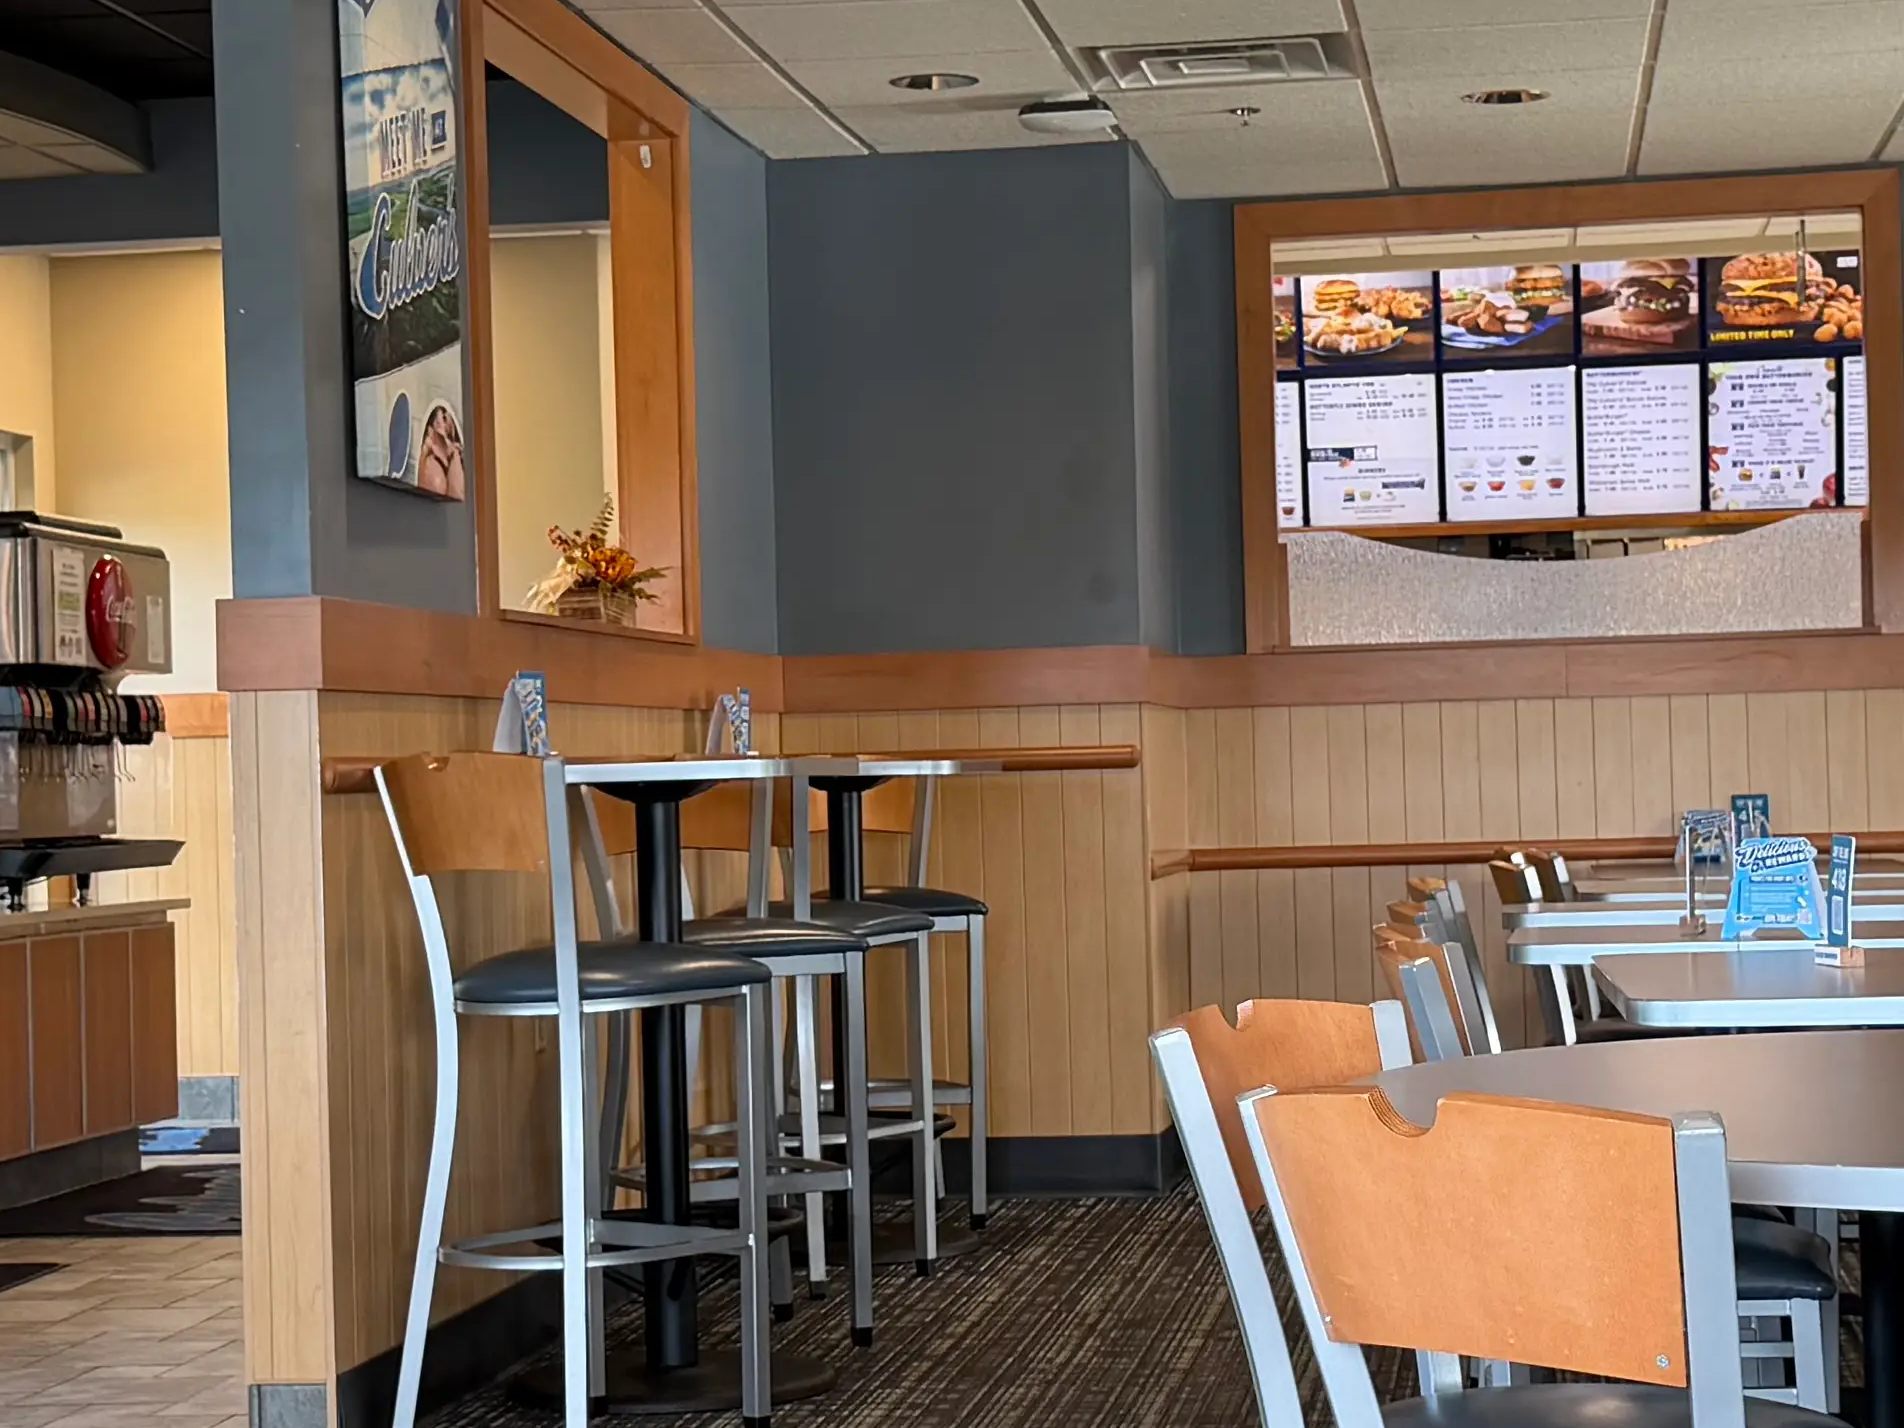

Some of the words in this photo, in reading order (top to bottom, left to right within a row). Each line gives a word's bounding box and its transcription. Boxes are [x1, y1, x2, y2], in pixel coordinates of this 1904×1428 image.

[379, 112, 408, 180] MEET
[409, 107, 428, 170] ME
[358, 173, 459, 318] Culver's
[1710, 331, 1746, 342] LIMITED
[1747, 330, 1769, 341] TIME
[1770, 329, 1795, 339] ONLY
[1736, 838, 1810, 867] Delicious
